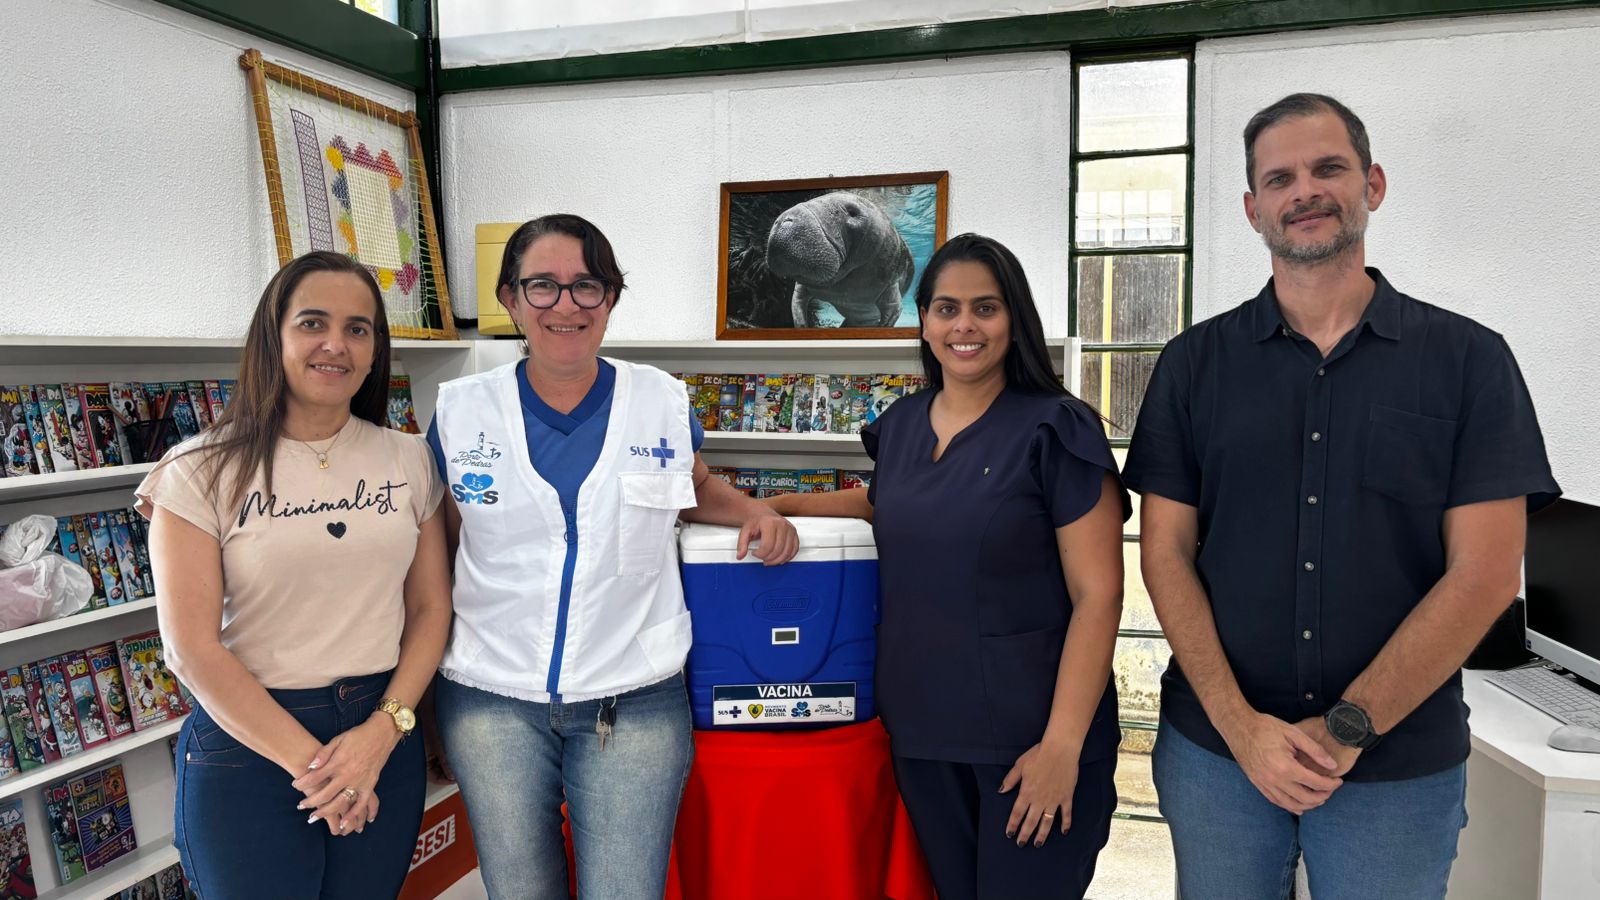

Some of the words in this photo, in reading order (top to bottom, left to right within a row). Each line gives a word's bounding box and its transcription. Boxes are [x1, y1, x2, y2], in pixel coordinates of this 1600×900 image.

[630, 445, 650, 457] SUS
[460, 459, 492, 468] Pedras
[451, 484, 499, 504] SMS
[239, 479, 408, 529] Minimalist
[758, 685, 813, 698] VACINA
[791, 708, 812, 717] SMS
[411, 821, 451, 865] SESI
